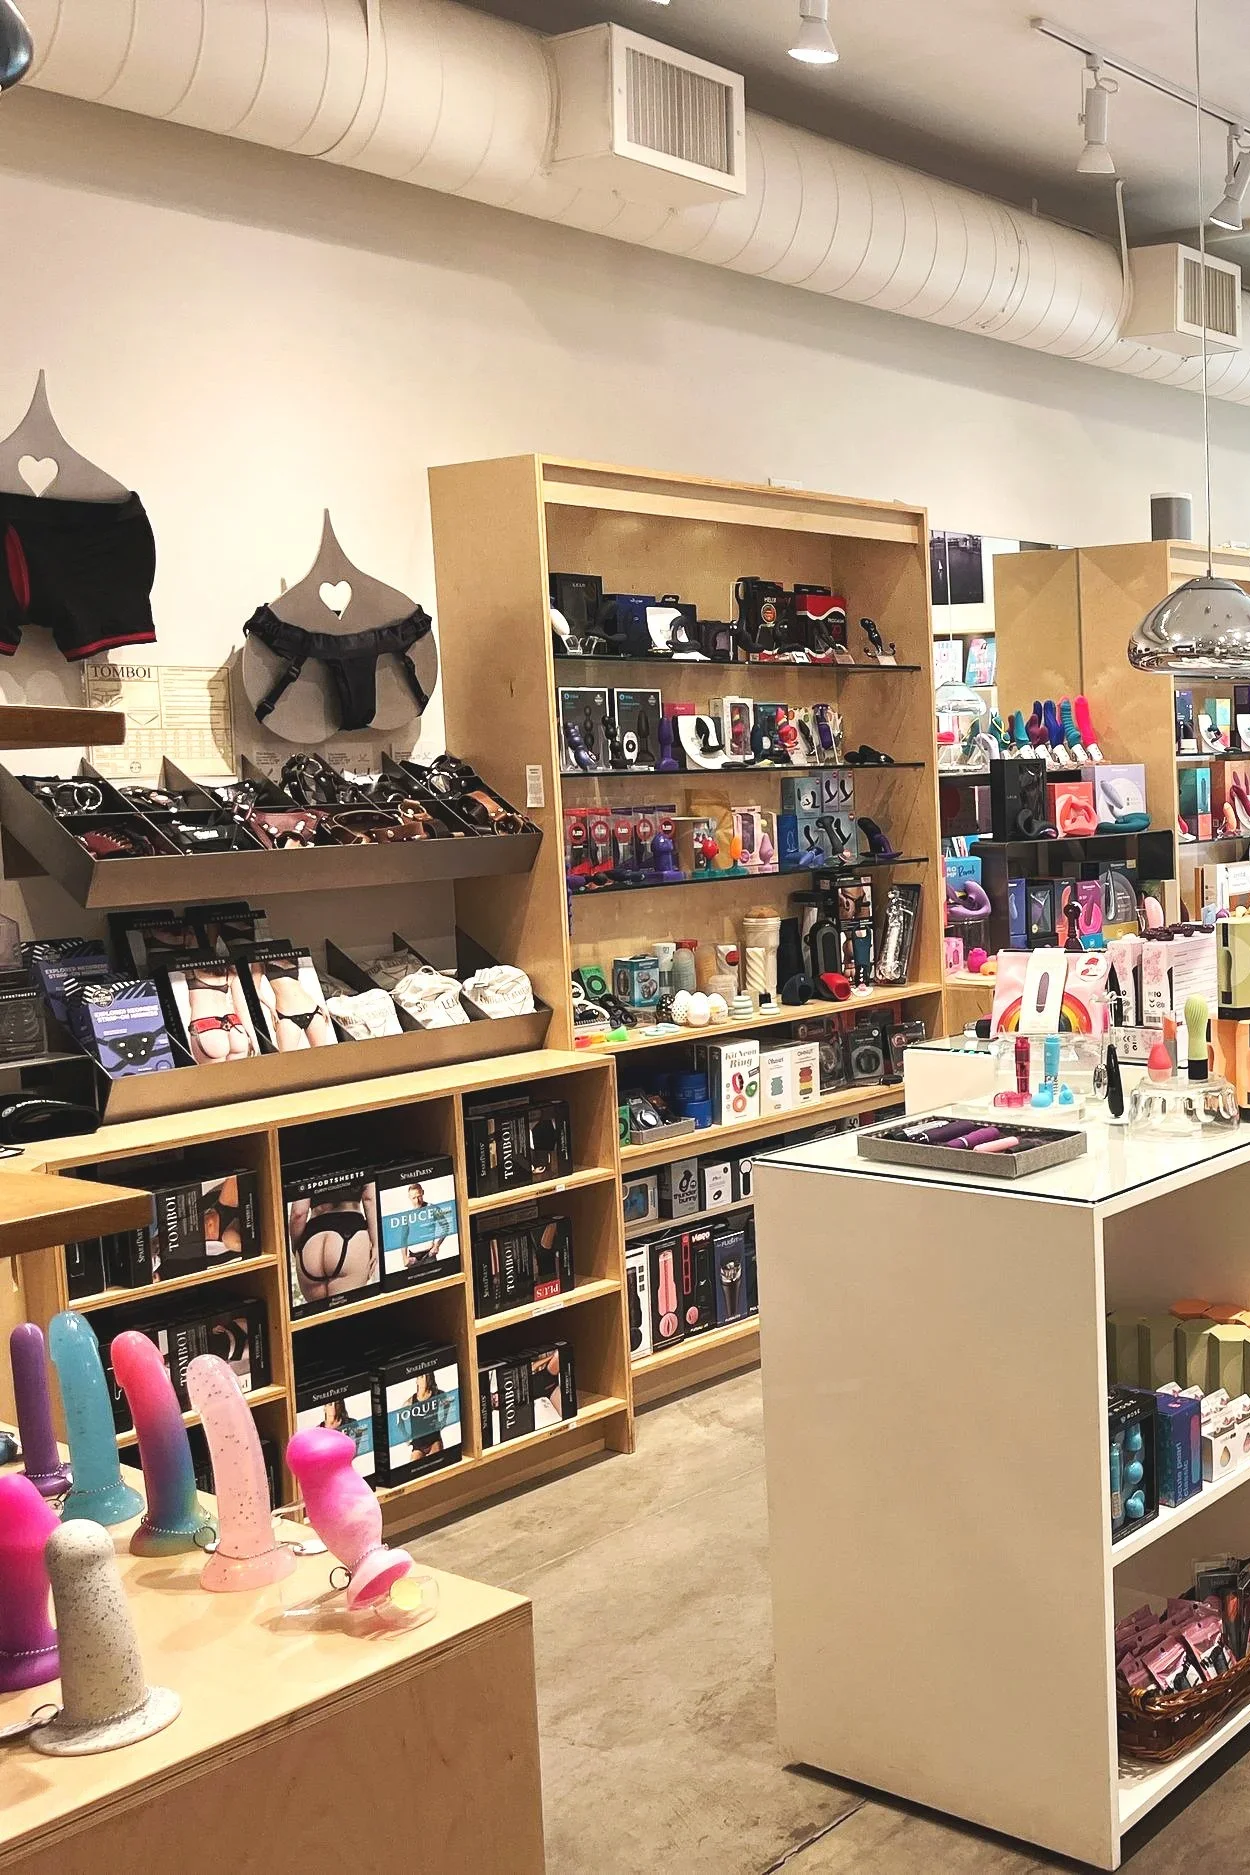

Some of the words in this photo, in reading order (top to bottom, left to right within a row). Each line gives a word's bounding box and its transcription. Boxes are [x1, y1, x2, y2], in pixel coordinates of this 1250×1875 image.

[89, 665, 151, 679] TOMBOI
[260, 951, 303, 961] SPORTSHEETS
[180, 958, 226, 969] SPORTSHEETS
[730, 1058, 752, 1069] Ring
[307, 1170, 366, 1190] SPORTSHEETS
[678, 1195, 698, 1205] bunny
[165, 1195, 180, 1253] TOMBOI
[390, 1208, 436, 1229] DEUCE
[536, 1283, 559, 1298] PLUS
[395, 1400, 438, 1425] JOQUE
